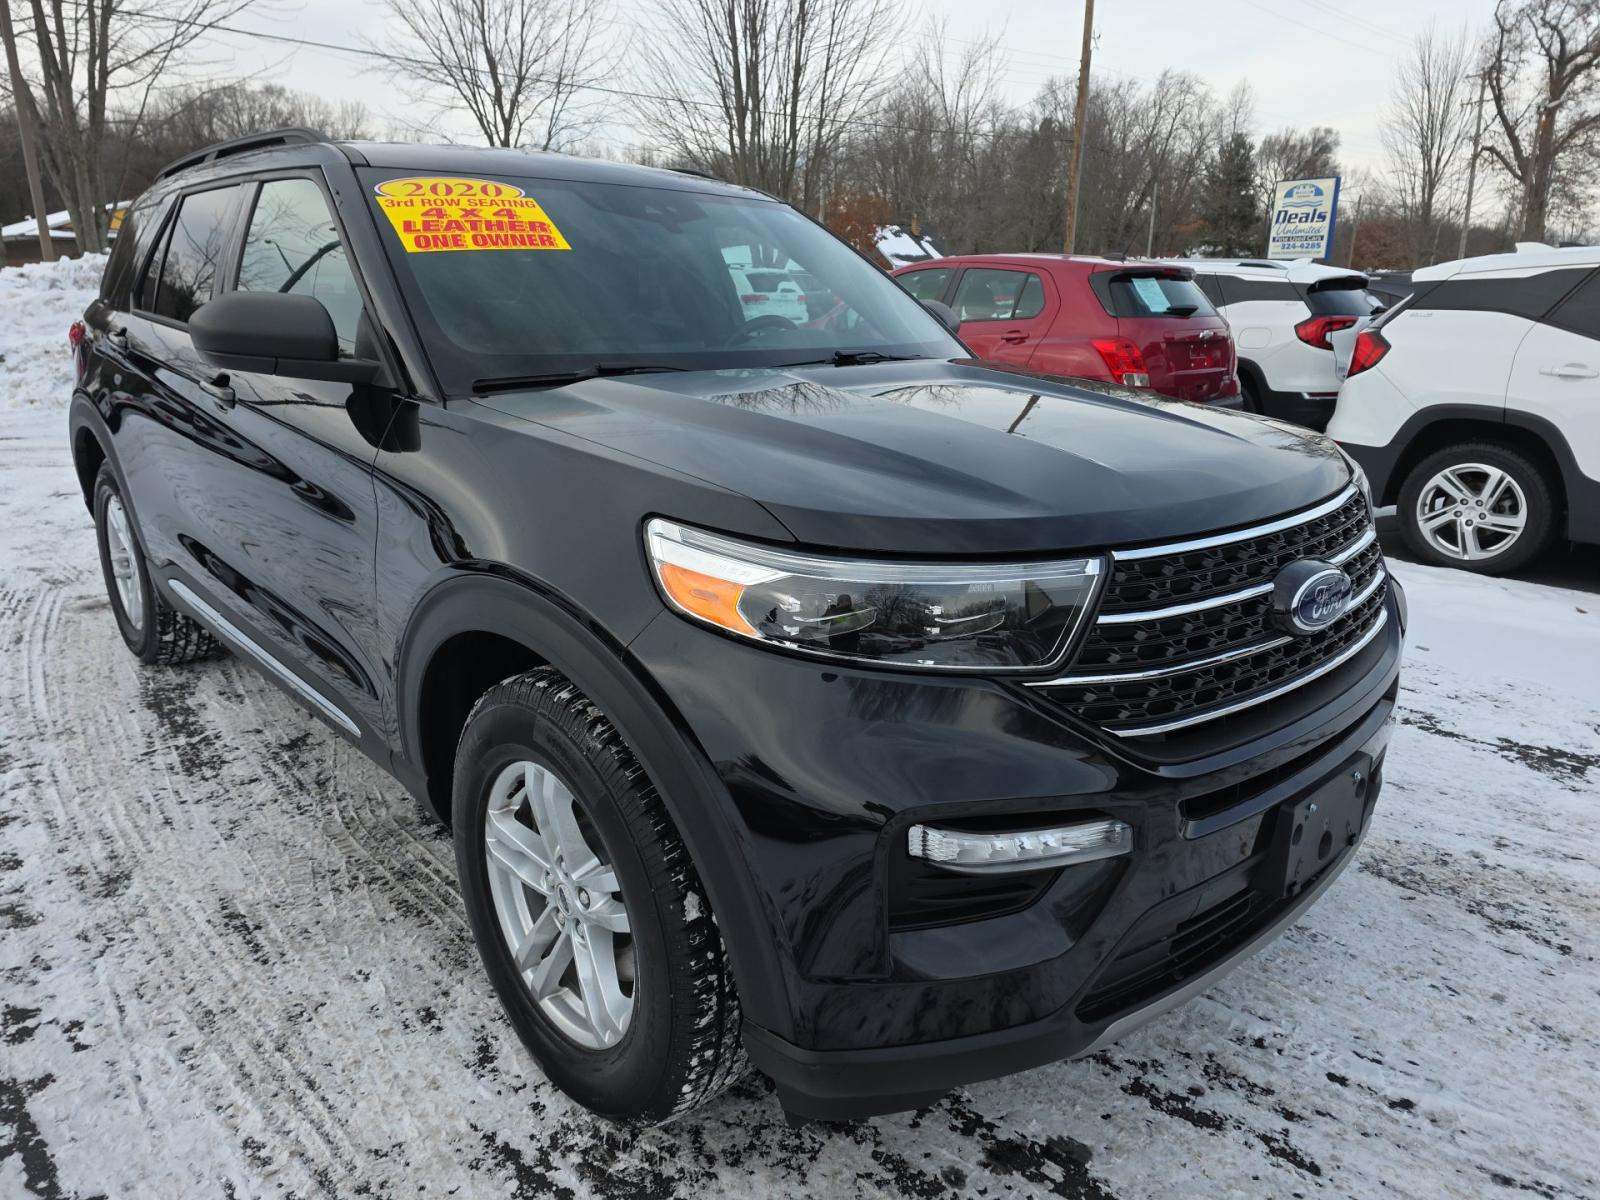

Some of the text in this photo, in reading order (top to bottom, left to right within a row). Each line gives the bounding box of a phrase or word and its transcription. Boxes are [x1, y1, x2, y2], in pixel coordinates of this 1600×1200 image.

[402, 182, 503, 197] 2020
[385, 198, 537, 209] 3rd ROW SEATING
[1275, 208, 1328, 224] Deals
[402, 219, 552, 234] LEATHER
[413, 234, 557, 249] ONE OWNER
[1312, 582, 1343, 619] Ford
